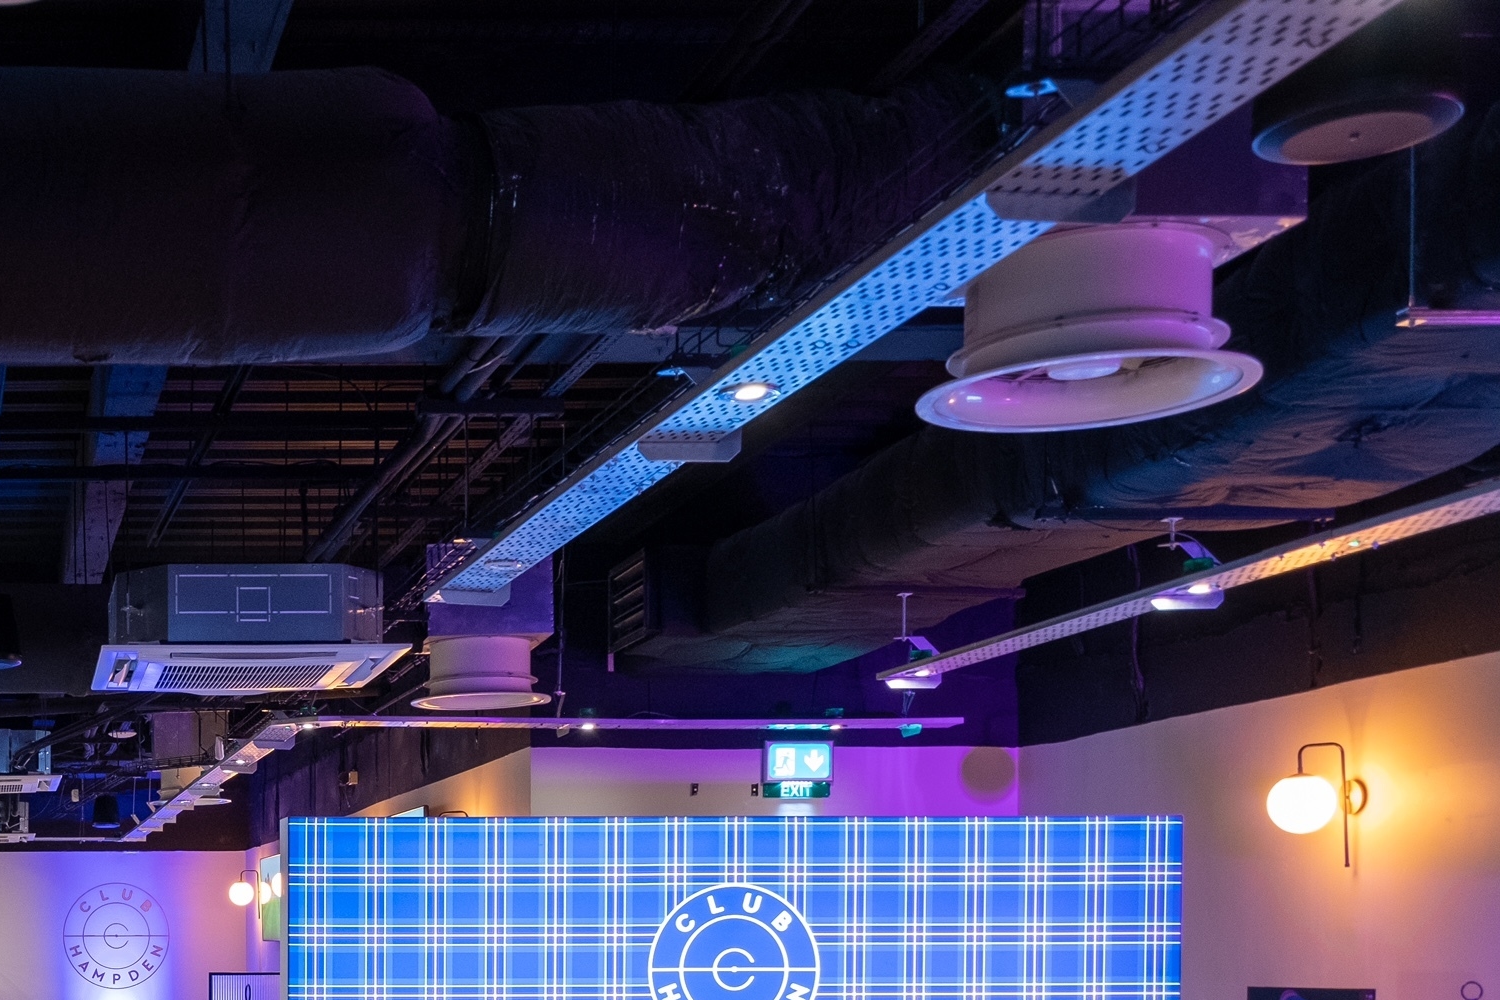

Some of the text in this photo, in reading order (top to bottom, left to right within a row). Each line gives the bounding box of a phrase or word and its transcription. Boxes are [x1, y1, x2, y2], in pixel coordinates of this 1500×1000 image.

[780, 782, 813, 797] EXIT
[79, 888, 153, 913] CLUB
[675, 892, 793, 933] CLUB
[69, 944, 164, 985] HAMPDEN
